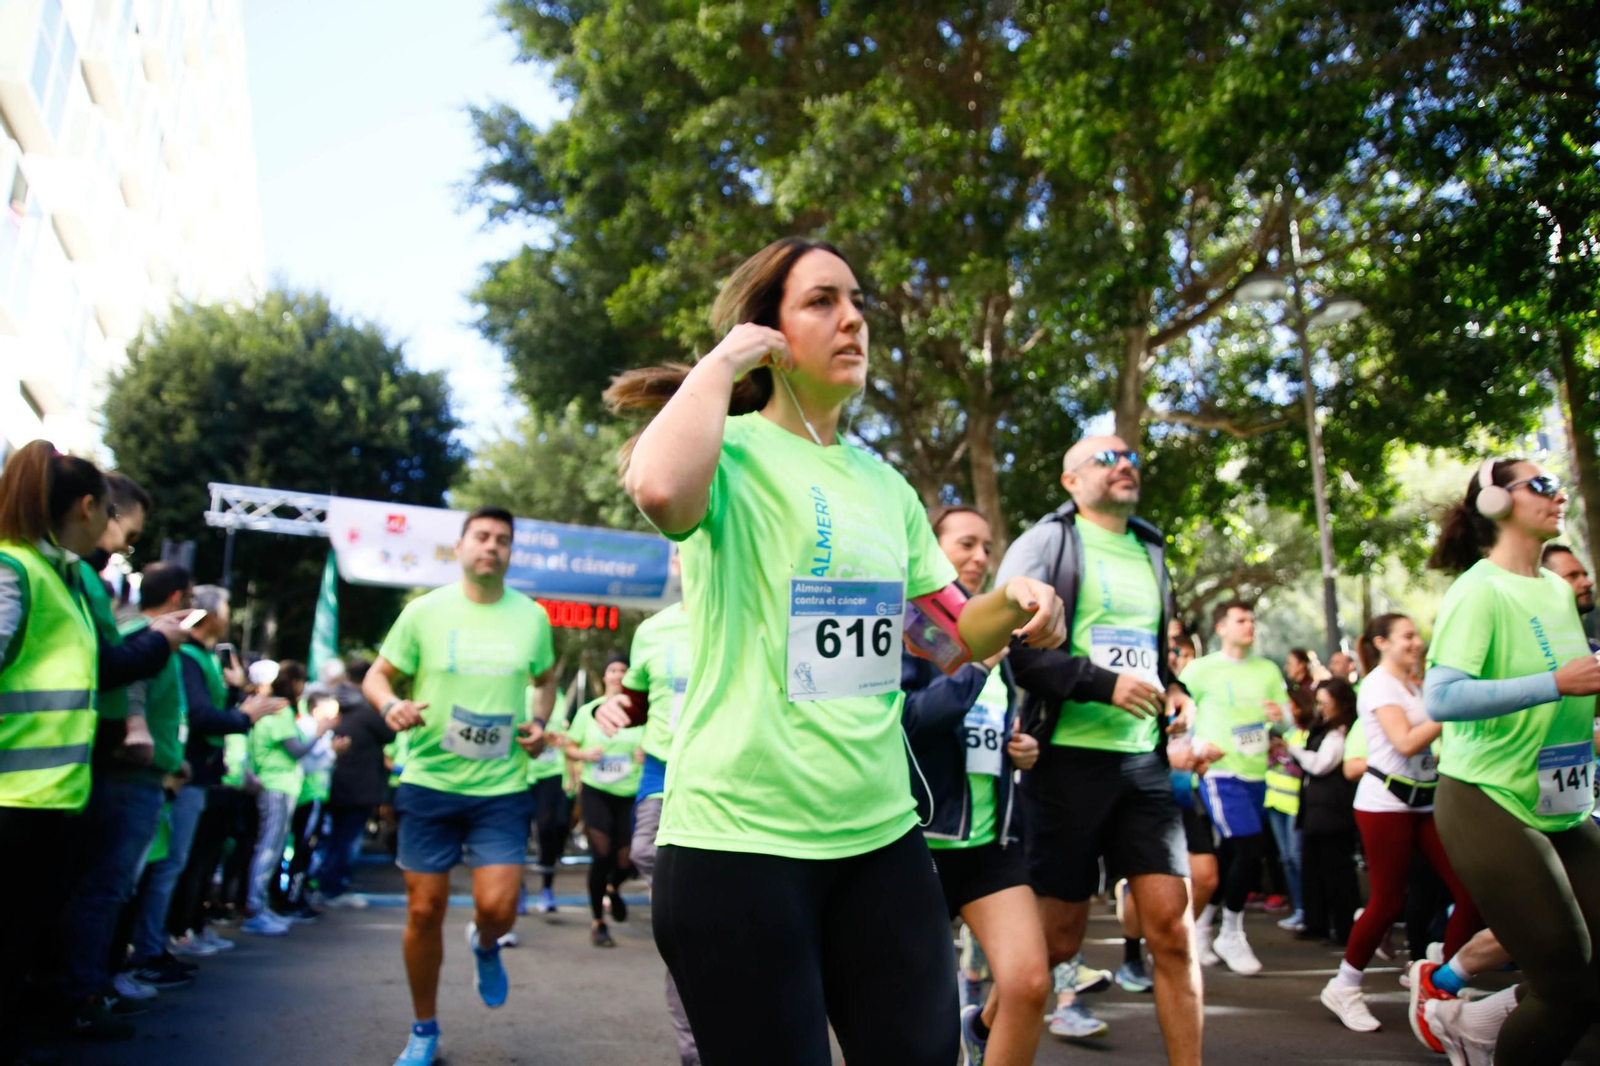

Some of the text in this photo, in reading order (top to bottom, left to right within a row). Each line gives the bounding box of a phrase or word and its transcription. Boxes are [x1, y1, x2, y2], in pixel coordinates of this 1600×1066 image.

[809, 486, 832, 577] ALMERÍA
[546, 552, 568, 572] el
[795, 583, 832, 594] Almería
[794, 595, 867, 605] contra el cáncer
[815, 617, 893, 658] 616
[1108, 646, 1152, 670] 200
[458, 726, 501, 746] 486
[1552, 764, 1589, 793] 141
